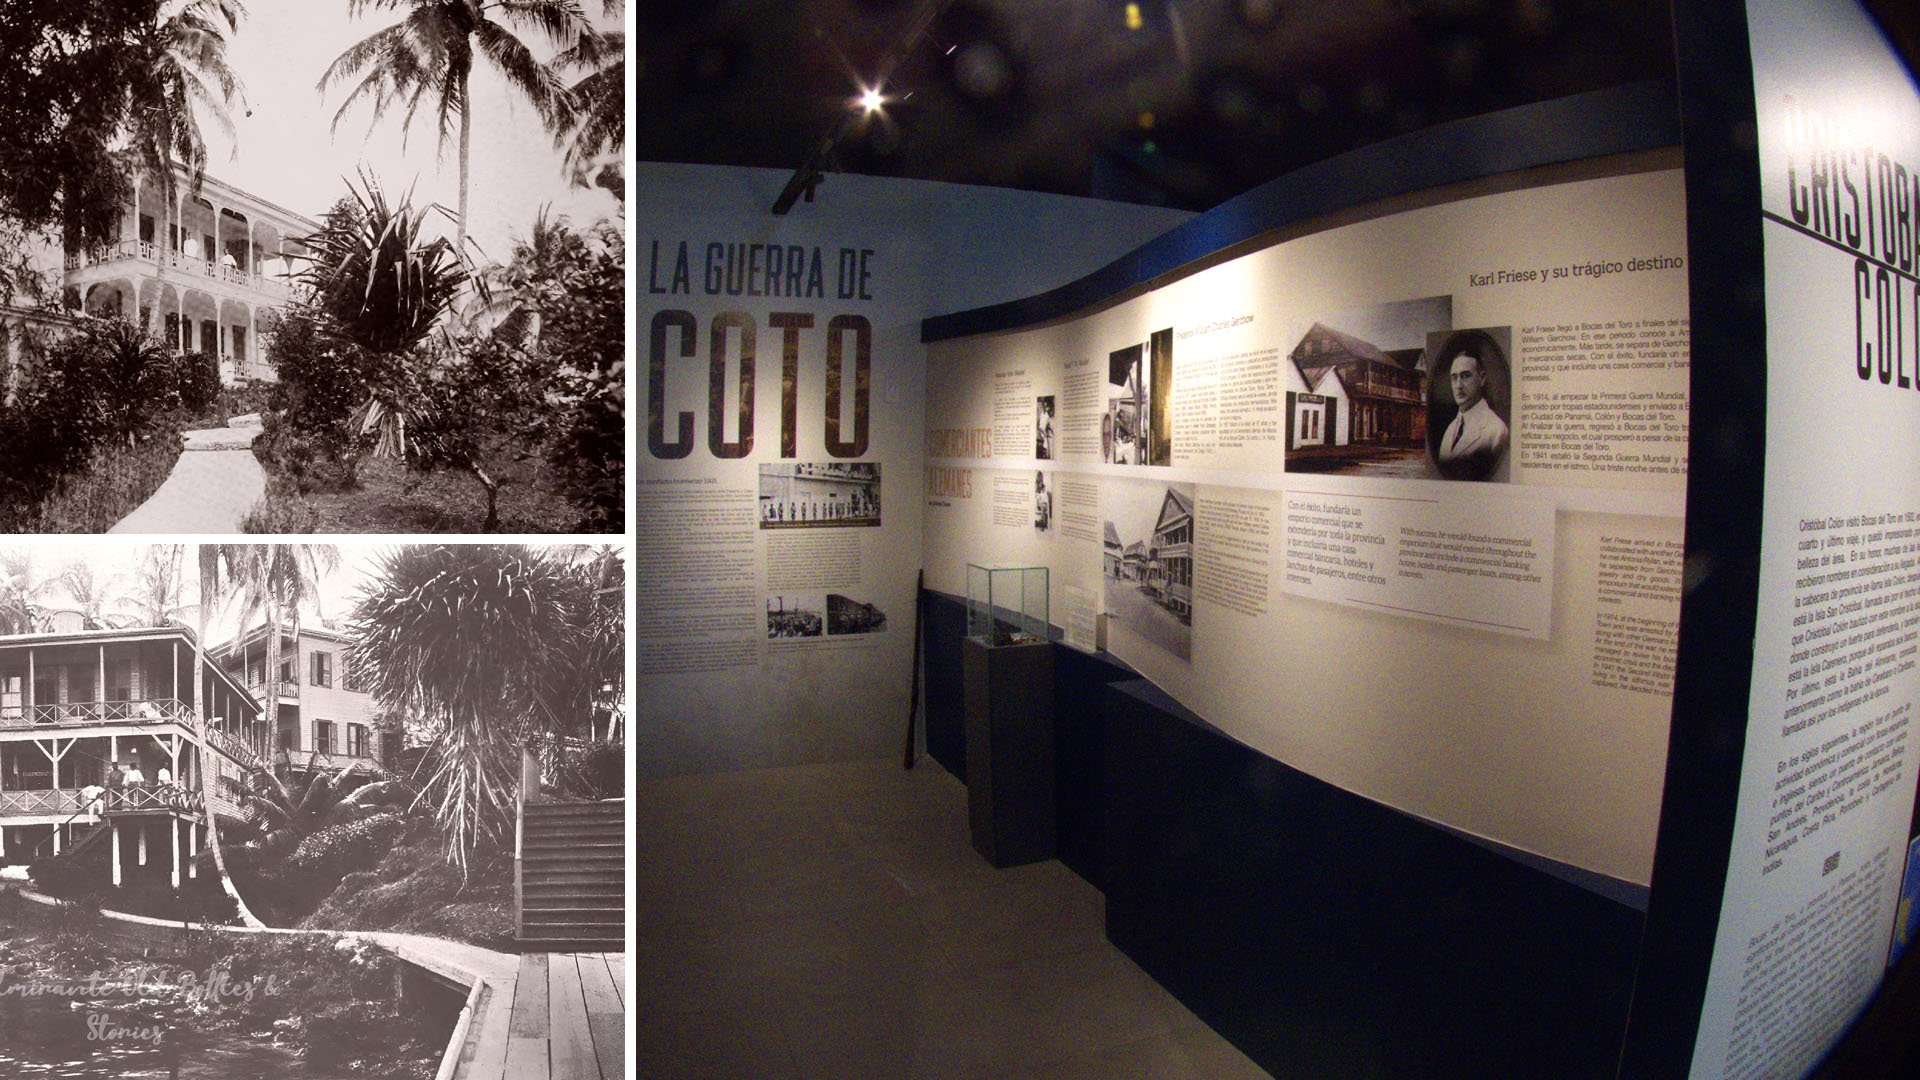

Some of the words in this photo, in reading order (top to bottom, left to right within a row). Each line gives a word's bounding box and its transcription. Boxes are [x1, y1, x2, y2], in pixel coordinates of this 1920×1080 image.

[650, 240, 690, 294] LA
[705, 242, 824, 298] GUERRA
[838, 248, 874, 300] DE
[1470, 272, 1494, 287] Karl
[1498, 270, 1537, 283] Friese
[1541, 268, 1549, 282] y
[1553, 267, 1568, 278] su
[1573, 260, 1623, 278] trágico
[1628, 255, 1683, 272] destino
[1619, 320, 1633, 328] Toro
[1590, 352, 1605, 360] Con
[1631, 361, 1665, 369] comercial
[648, 309, 871, 460] COTO
[1624, 423, 1646, 431] Bocas
[1664, 423, 1678, 431] Toro
[1583, 453, 1612, 461] Segunda
[1616, 454, 1639, 462] Guerra
[1643, 454, 1671, 463] Mundial
[1626, 464, 1647, 472] noche
[1352, 534, 1385, 544] provincia
